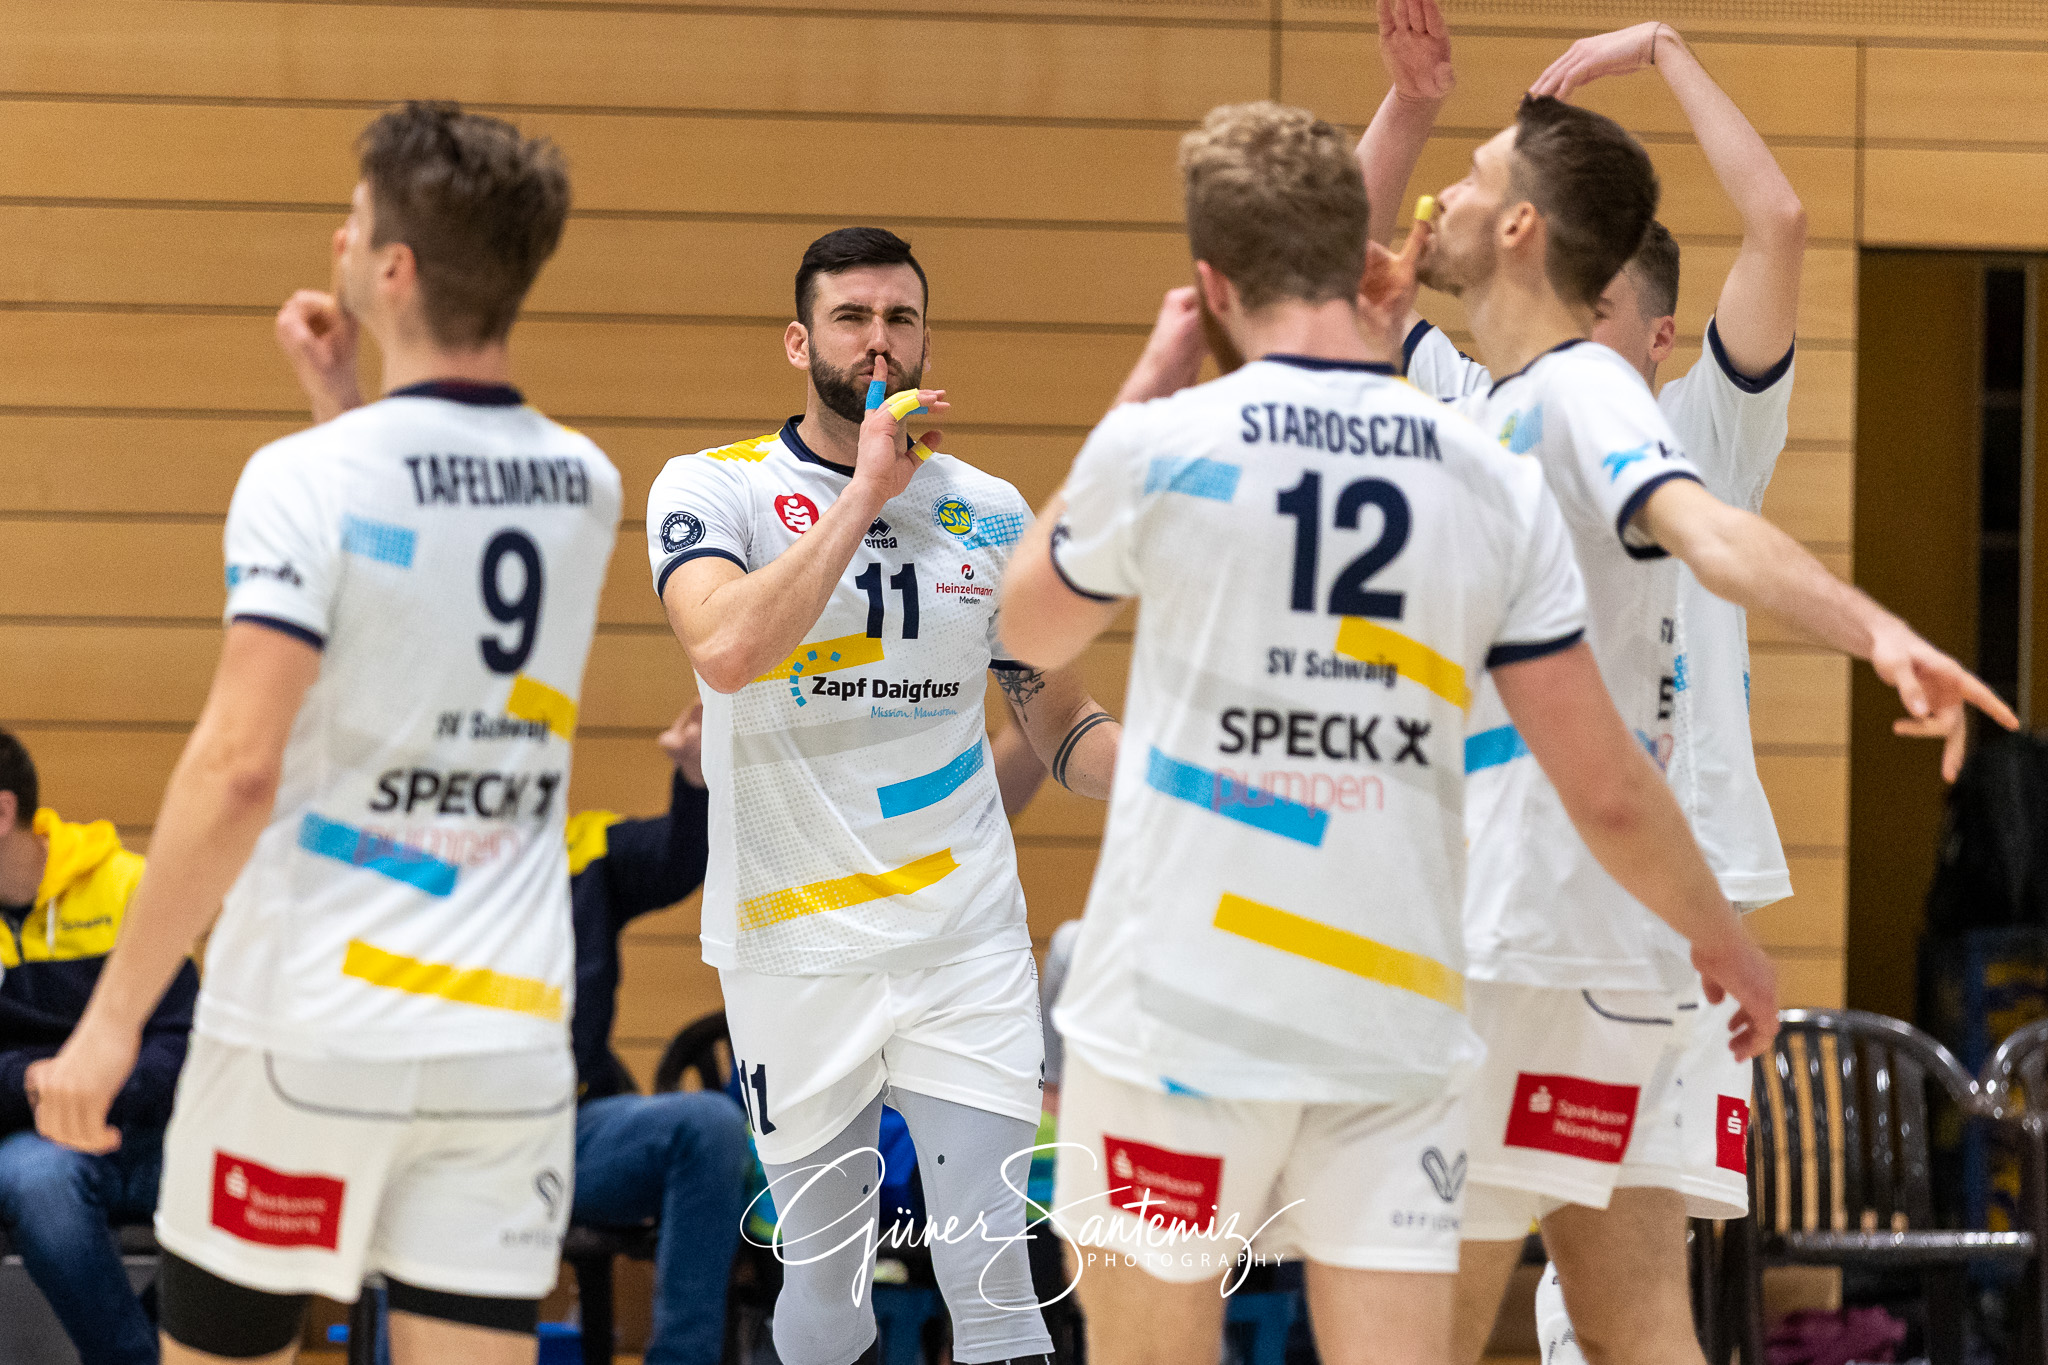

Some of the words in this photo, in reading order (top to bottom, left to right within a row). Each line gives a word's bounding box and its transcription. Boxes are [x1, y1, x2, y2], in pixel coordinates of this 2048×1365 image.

[1240, 402, 1443, 461] STAROSCZIK
[1276, 469, 1413, 620] 12
[478, 527, 546, 675] 9
[855, 562, 920, 639] 11
[936, 582, 994, 596] Heinzelmann
[959, 595, 980, 605] Medien
[812, 676, 867, 701] Zapf
[872, 679, 960, 703] Daigfuss
[1305, 650, 1397, 688] Schwaig
[1219, 707, 1380, 761] SPECK
[369, 766, 530, 818] SPECK
[1212, 767, 1384, 818] pumpen
[740, 1059, 776, 1135] 11
